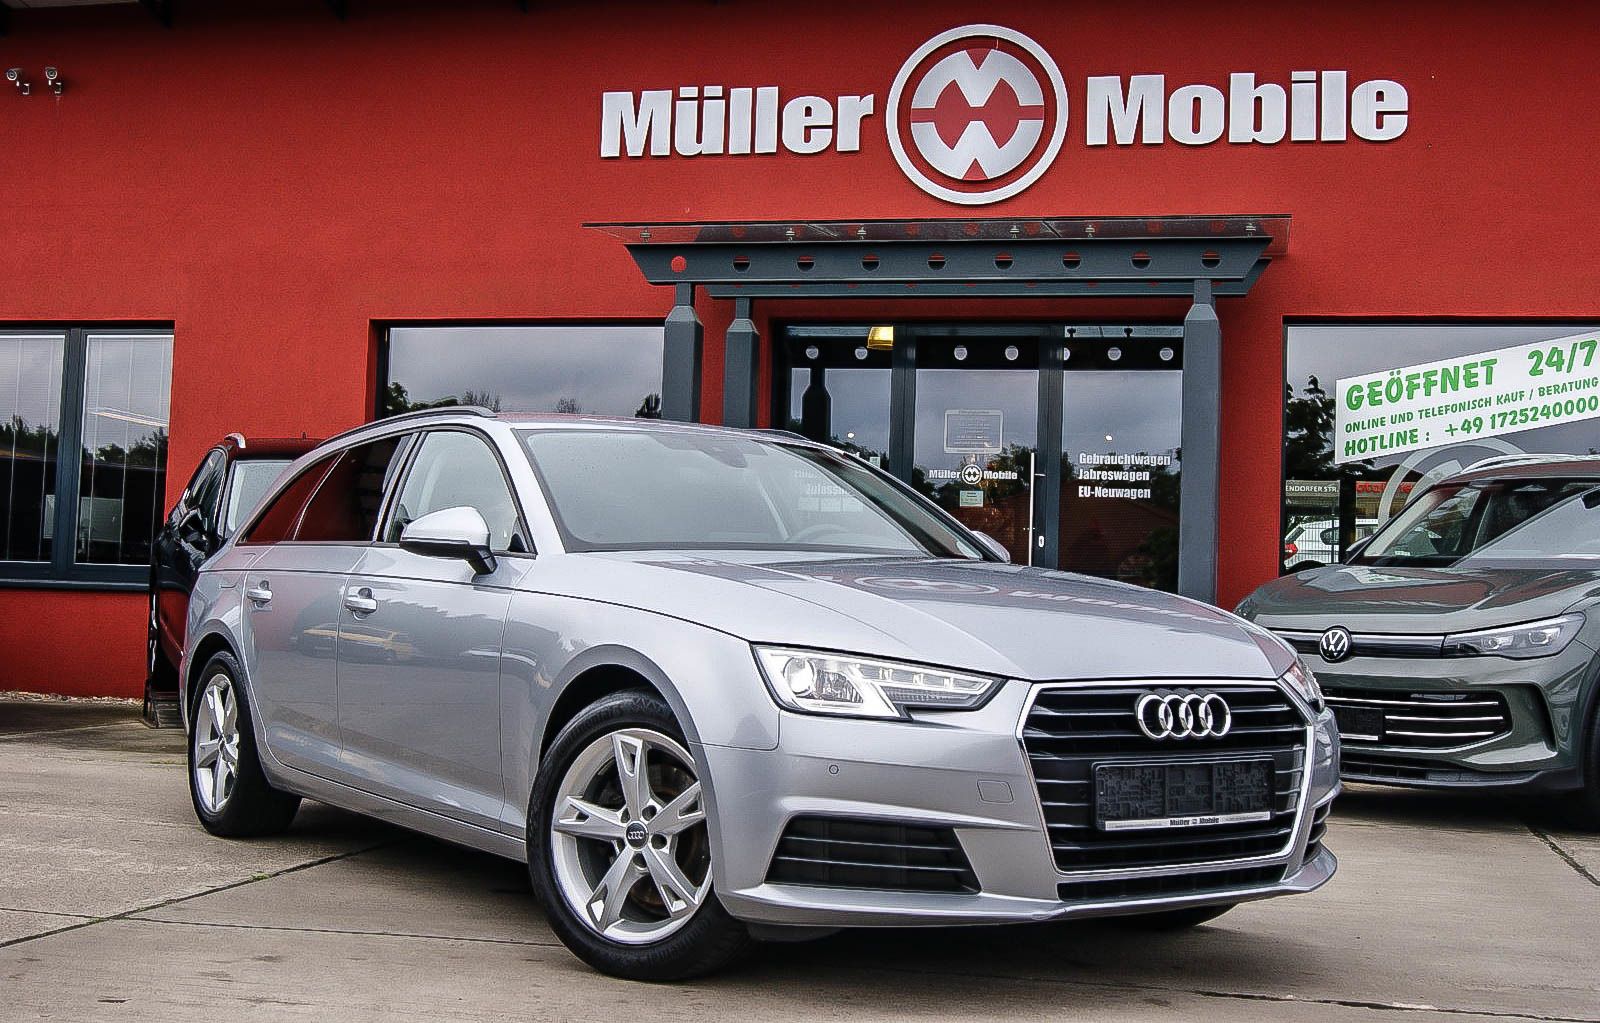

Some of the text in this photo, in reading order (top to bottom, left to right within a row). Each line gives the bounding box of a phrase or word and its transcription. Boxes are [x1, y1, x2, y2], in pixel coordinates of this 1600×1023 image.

[600, 70, 1409, 158] Müller Mobile
[1346, 339, 1598, 411] GEÖFFNET 24/7
[1345, 376, 1599, 434] ONLINE UND TELEFONISCH KAUF / BERATUNG
[1344, 428, 1418, 457] HOTLINE
[1444, 416, 1484, 437] +49
[1490, 395, 1599, 430] 1725240000
[928, 469, 1018, 480] Müller Mobile
[1078, 468, 1150, 482] Jahreswagen
[1080, 452, 1171, 467] Gebrauchtwagen
[1078, 485, 1151, 500] EU-Neuwagen
